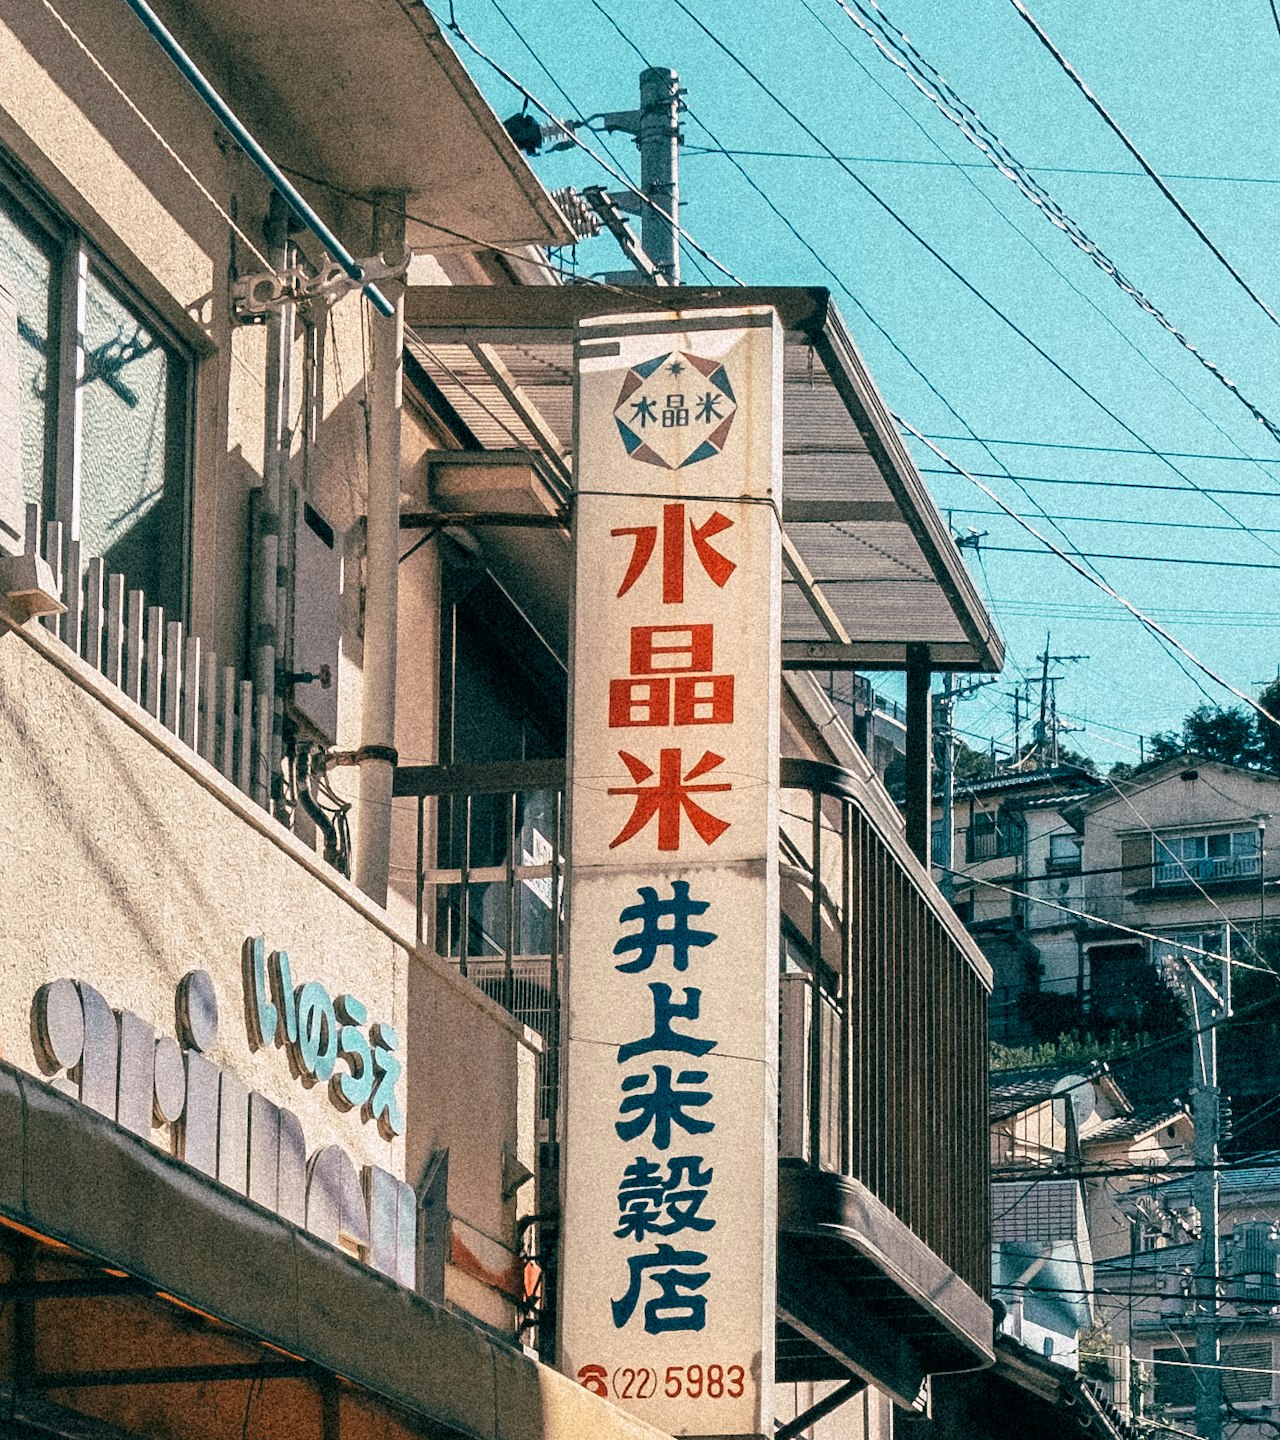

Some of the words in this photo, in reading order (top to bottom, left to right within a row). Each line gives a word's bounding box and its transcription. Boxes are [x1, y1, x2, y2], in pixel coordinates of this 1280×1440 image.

[629, 393, 726, 428] 水晶米
[608, 503, 737, 851] 水晶米
[241, 935, 407, 1142] いのうえ
[610, 880, 718, 1335] 井上米穀店
